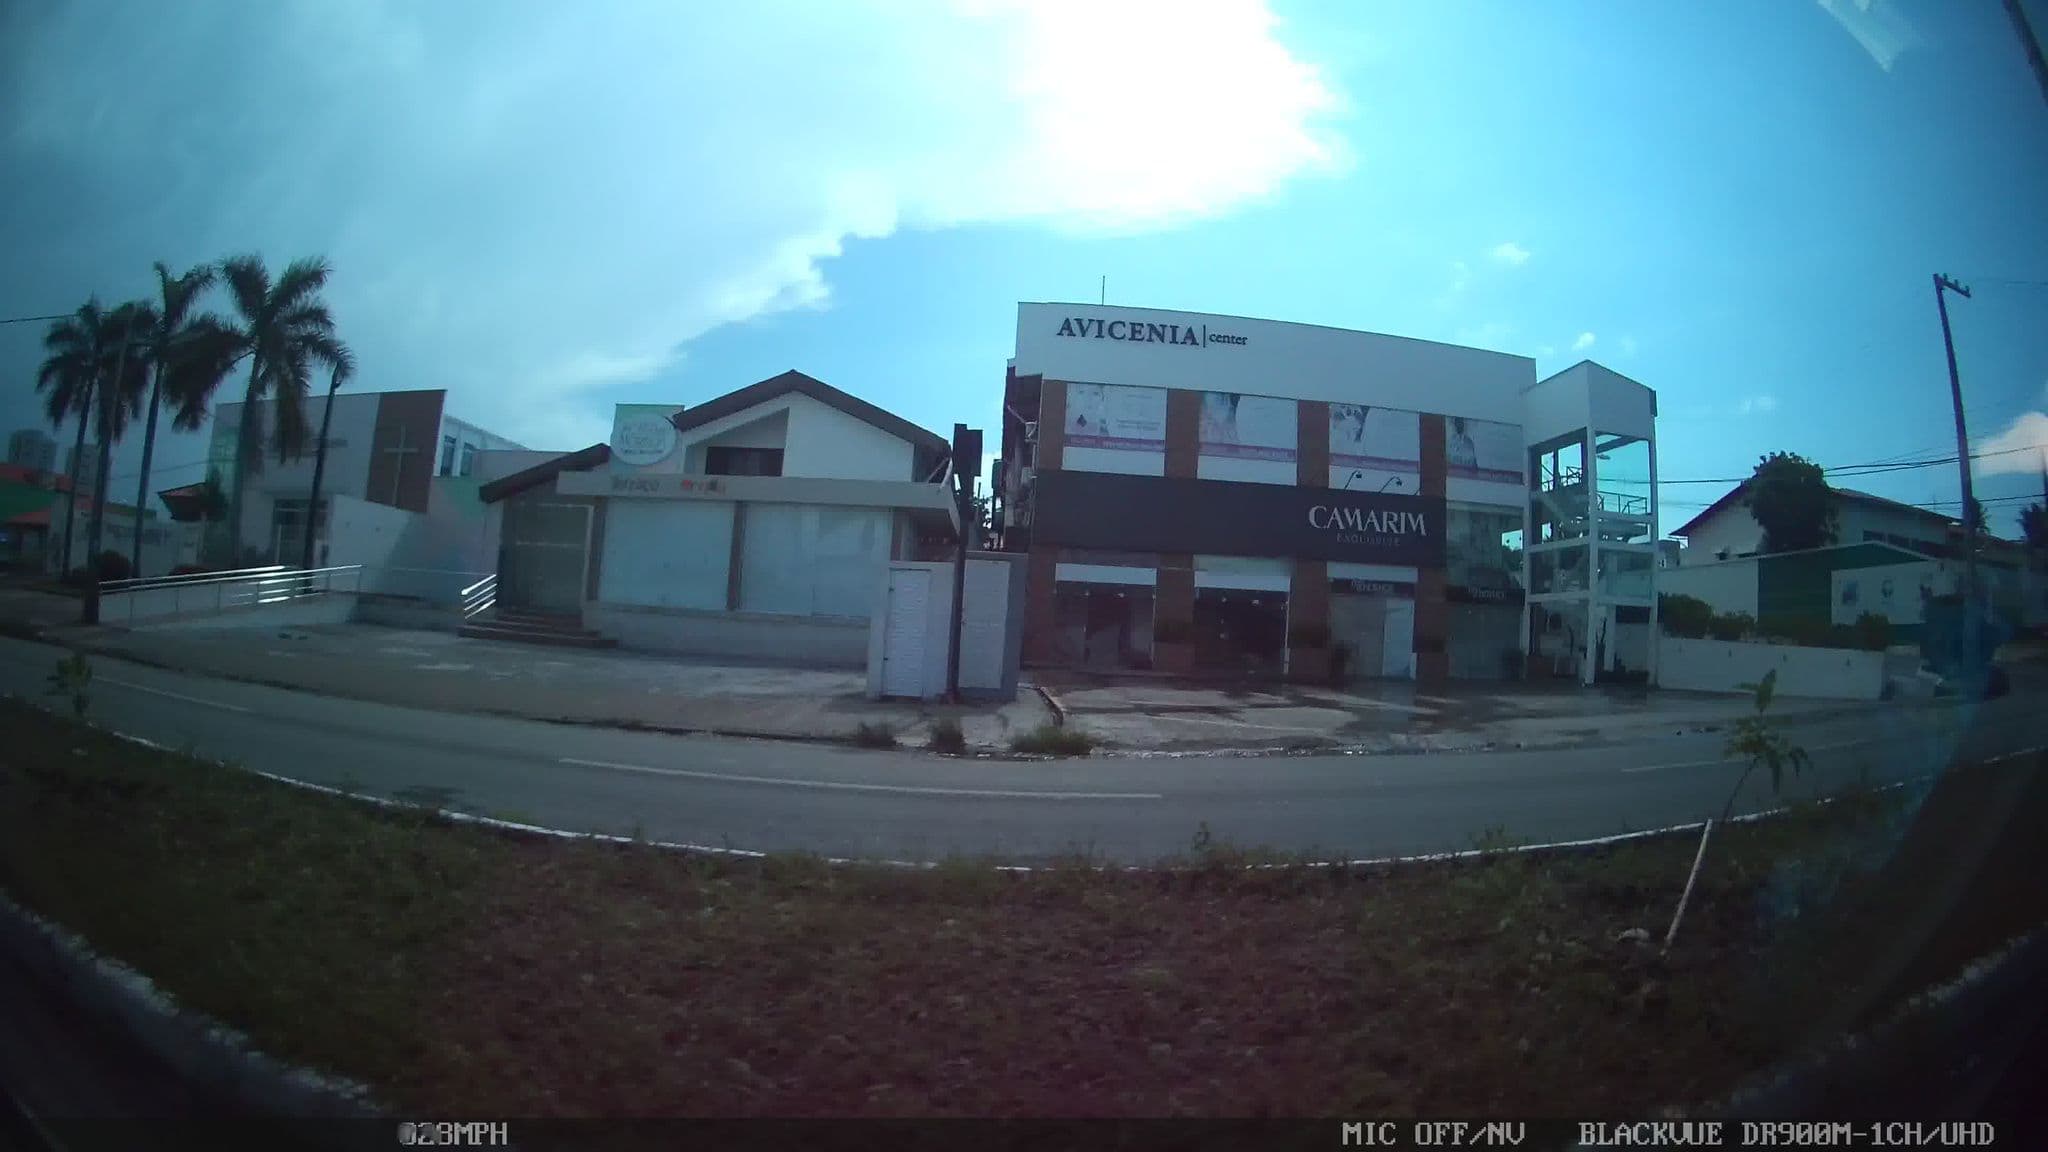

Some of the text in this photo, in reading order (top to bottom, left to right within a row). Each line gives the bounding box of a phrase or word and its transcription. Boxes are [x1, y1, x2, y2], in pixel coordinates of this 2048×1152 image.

[1056, 317, 1248, 346] AVICENIA center
[1308, 505, 1427, 537] CAMARIM
